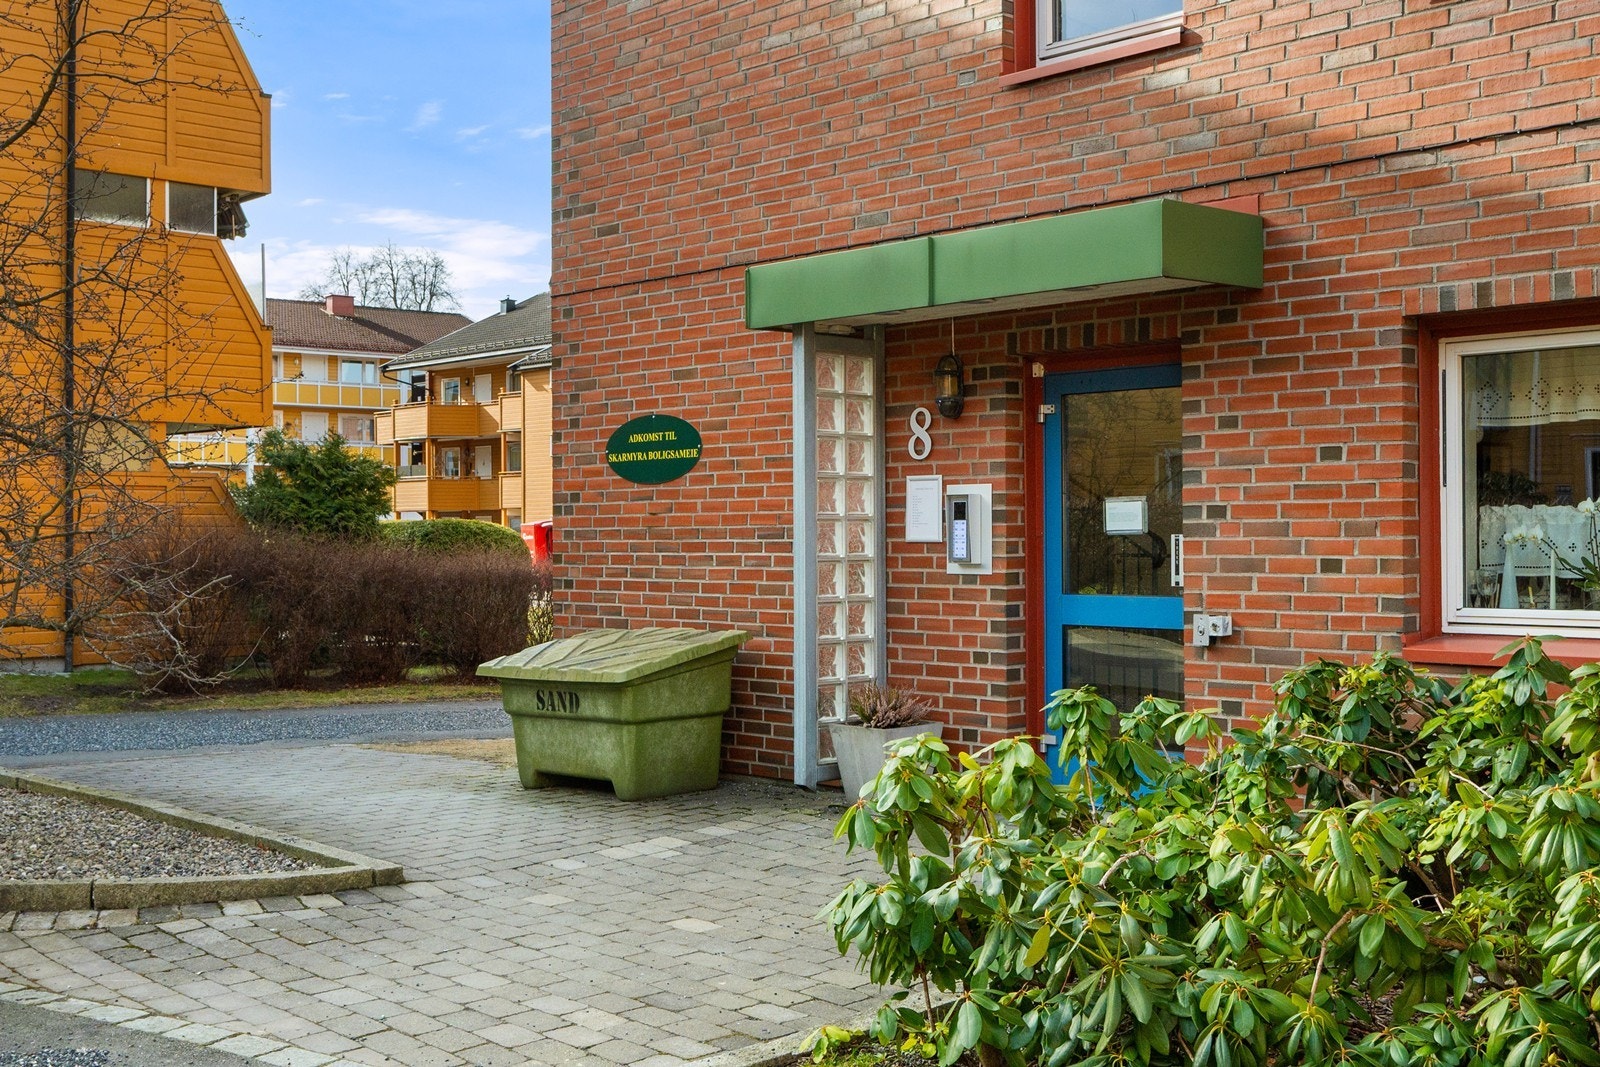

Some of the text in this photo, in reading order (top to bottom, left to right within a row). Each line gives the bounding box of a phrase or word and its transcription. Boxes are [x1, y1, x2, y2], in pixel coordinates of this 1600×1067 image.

[628, 431, 677, 443] ADKOMST TIL
[908, 407, 932, 460] 8
[608, 449, 698, 462] SKARMYRA BOLIGSAMEIE
[536, 689, 580, 713] SAND
